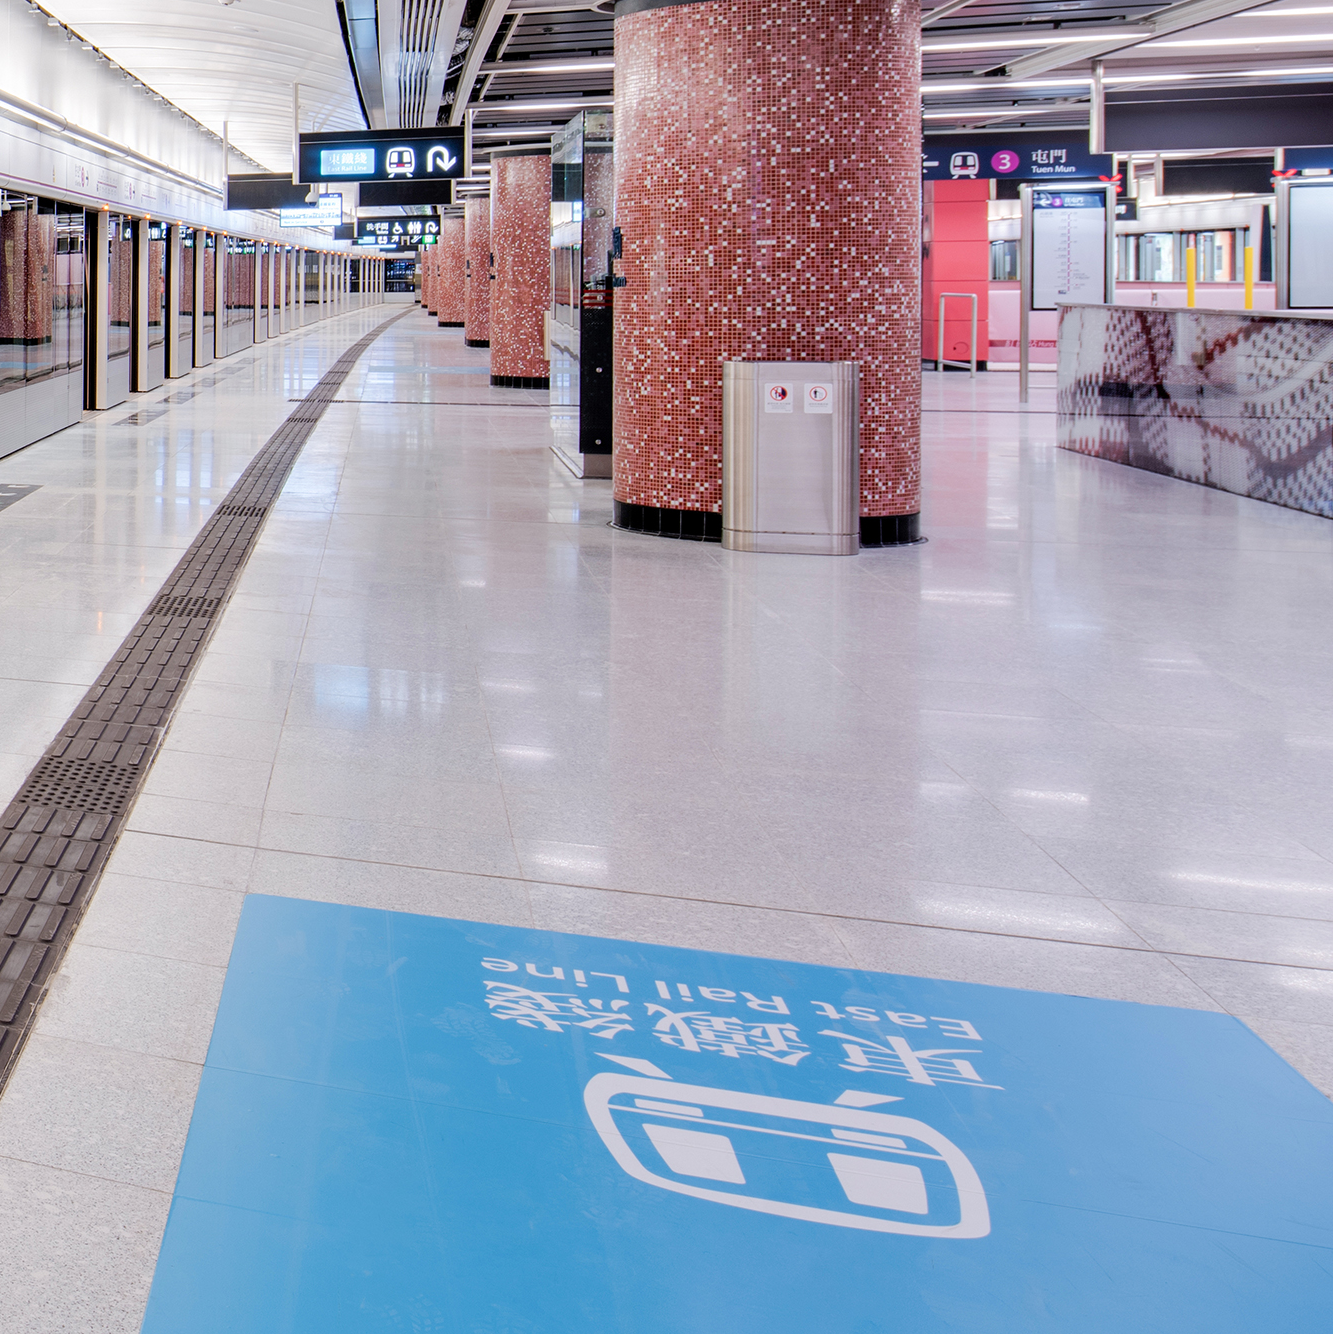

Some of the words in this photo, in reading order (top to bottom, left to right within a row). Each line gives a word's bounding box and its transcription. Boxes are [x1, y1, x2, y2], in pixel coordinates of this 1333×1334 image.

[999, 154, 1011, 170] 3
[1031, 149, 1067, 164] 屯門
[1055, 165, 1076, 173] Mun
[480, 956, 630, 994] Line
[654, 979, 791, 1016] Rail
[482, 980, 1006, 1091] 東鐵綫
[809, 1000, 983, 1041] East
